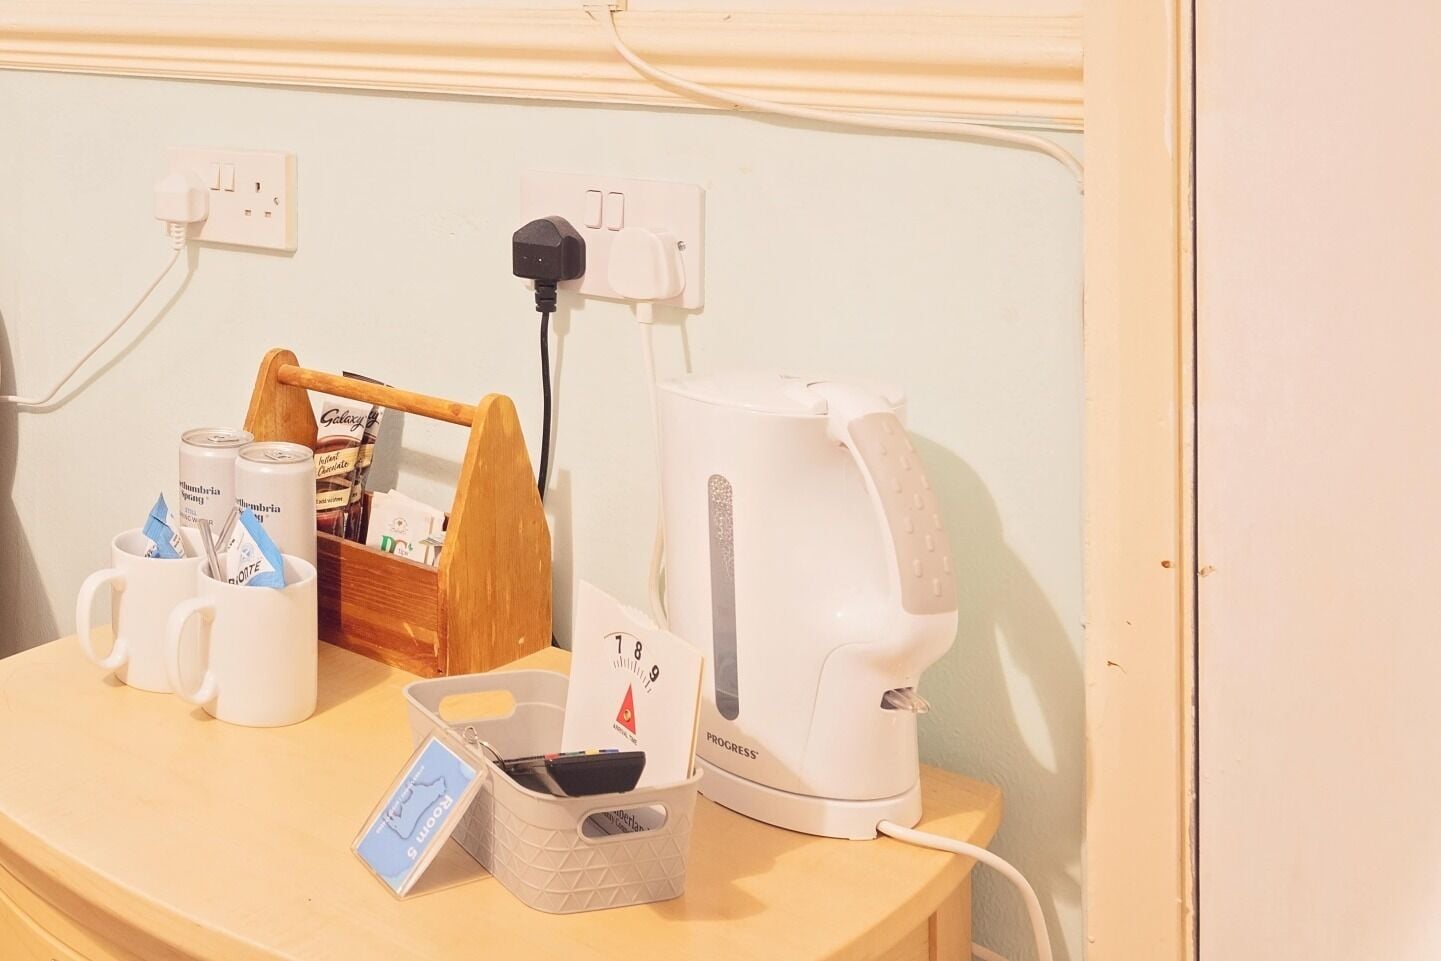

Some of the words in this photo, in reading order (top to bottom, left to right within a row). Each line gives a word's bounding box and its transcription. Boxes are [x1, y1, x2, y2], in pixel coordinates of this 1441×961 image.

[320, 408, 364, 432] Galaxy
[318, 451, 340, 465] Instant
[317, 460, 348, 477] Chocolate
[180, 490, 205, 505] Spring
[615, 634, 622, 654] 7
[634, 640, 643, 661] 8
[649, 664, 660, 682] 9
[628, 734, 638, 746] TIME
[706, 731, 757, 760] PROGRESS
[415, 794, 453, 843] Room
[407, 846, 418, 860] 5
